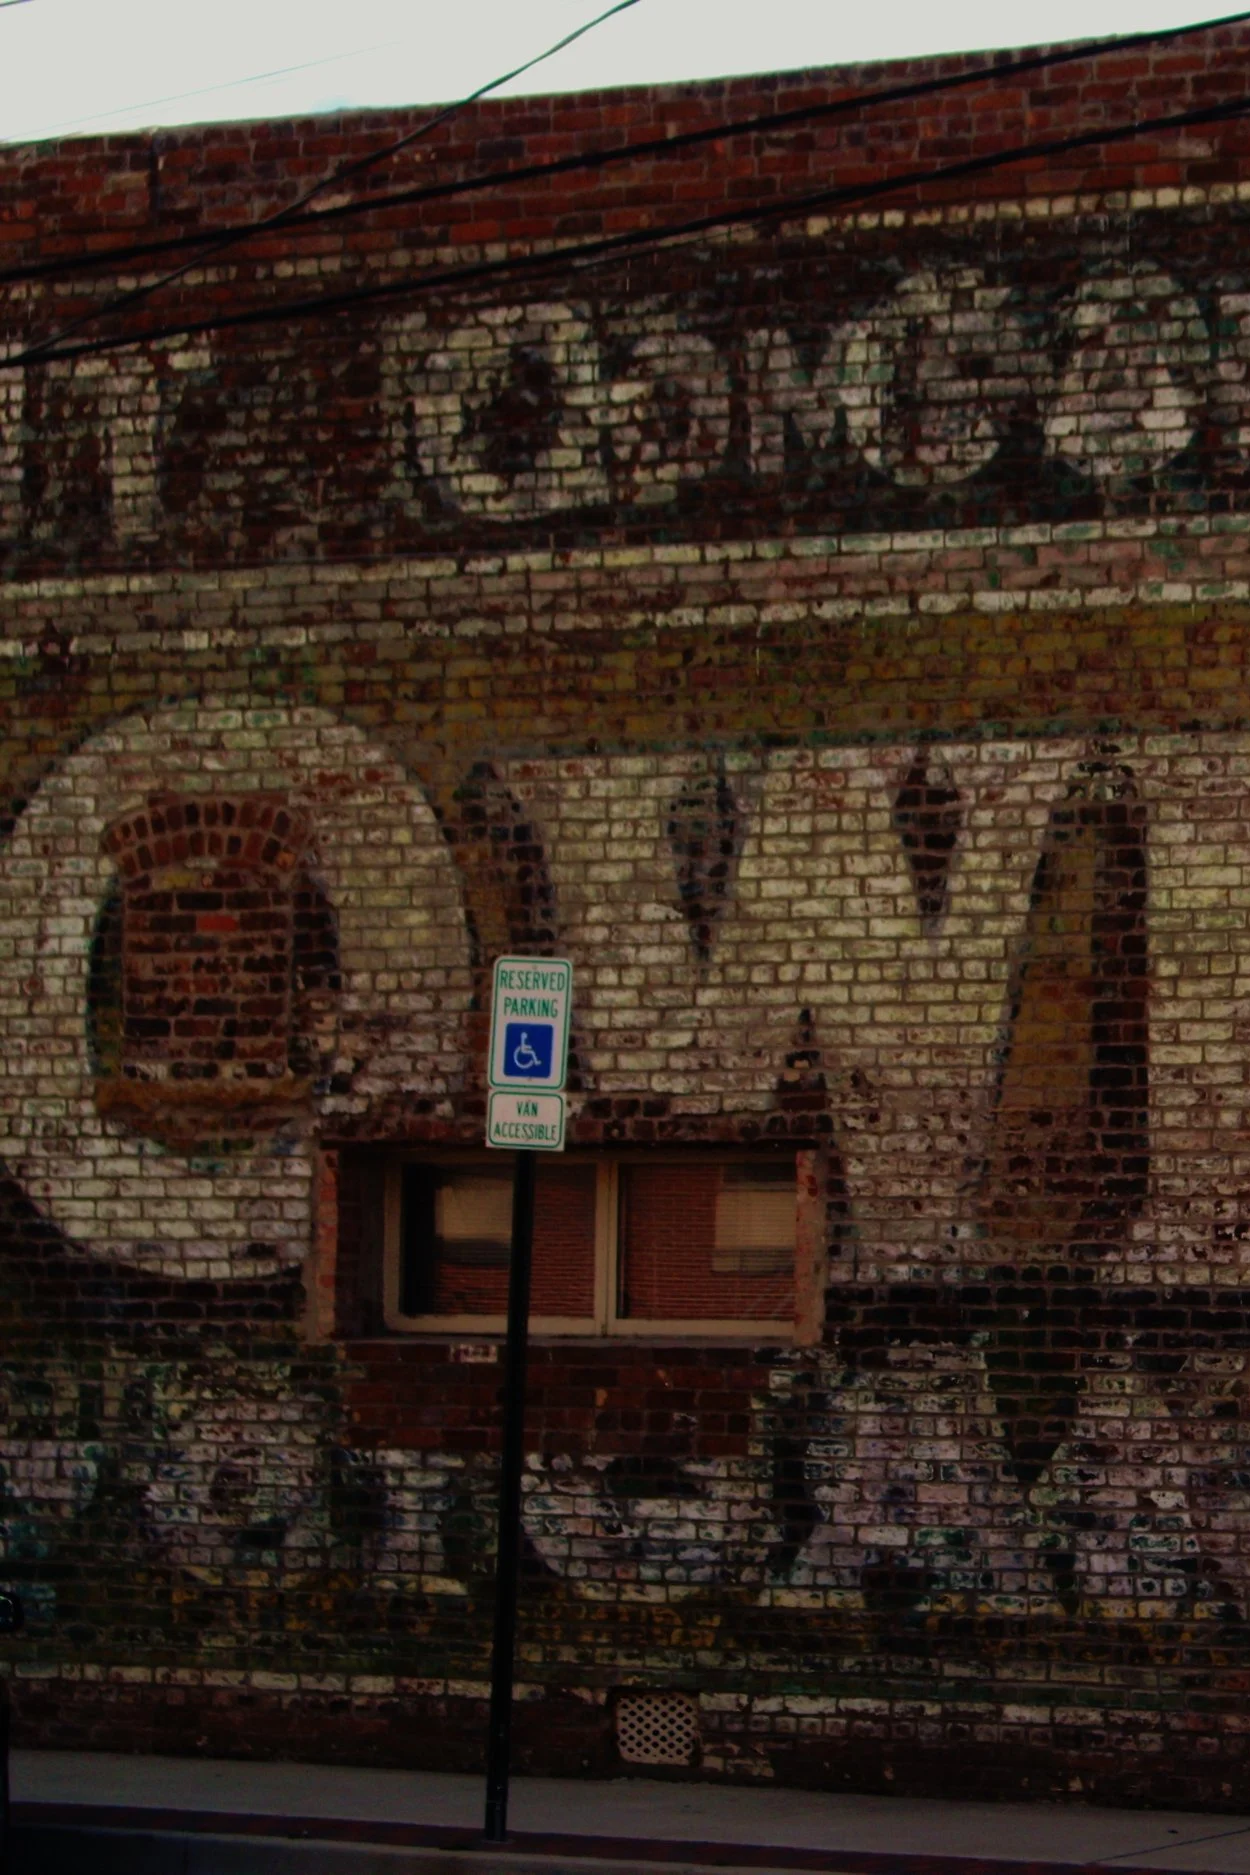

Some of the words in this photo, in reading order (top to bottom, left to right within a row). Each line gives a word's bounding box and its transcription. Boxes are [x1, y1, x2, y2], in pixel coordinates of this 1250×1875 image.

[500, 970, 565, 991] RESERVED
[504, 997, 559, 1018] PARKING
[517, 1102, 538, 1116] VAN
[494, 1125, 557, 1141] ACCESSIBLE
